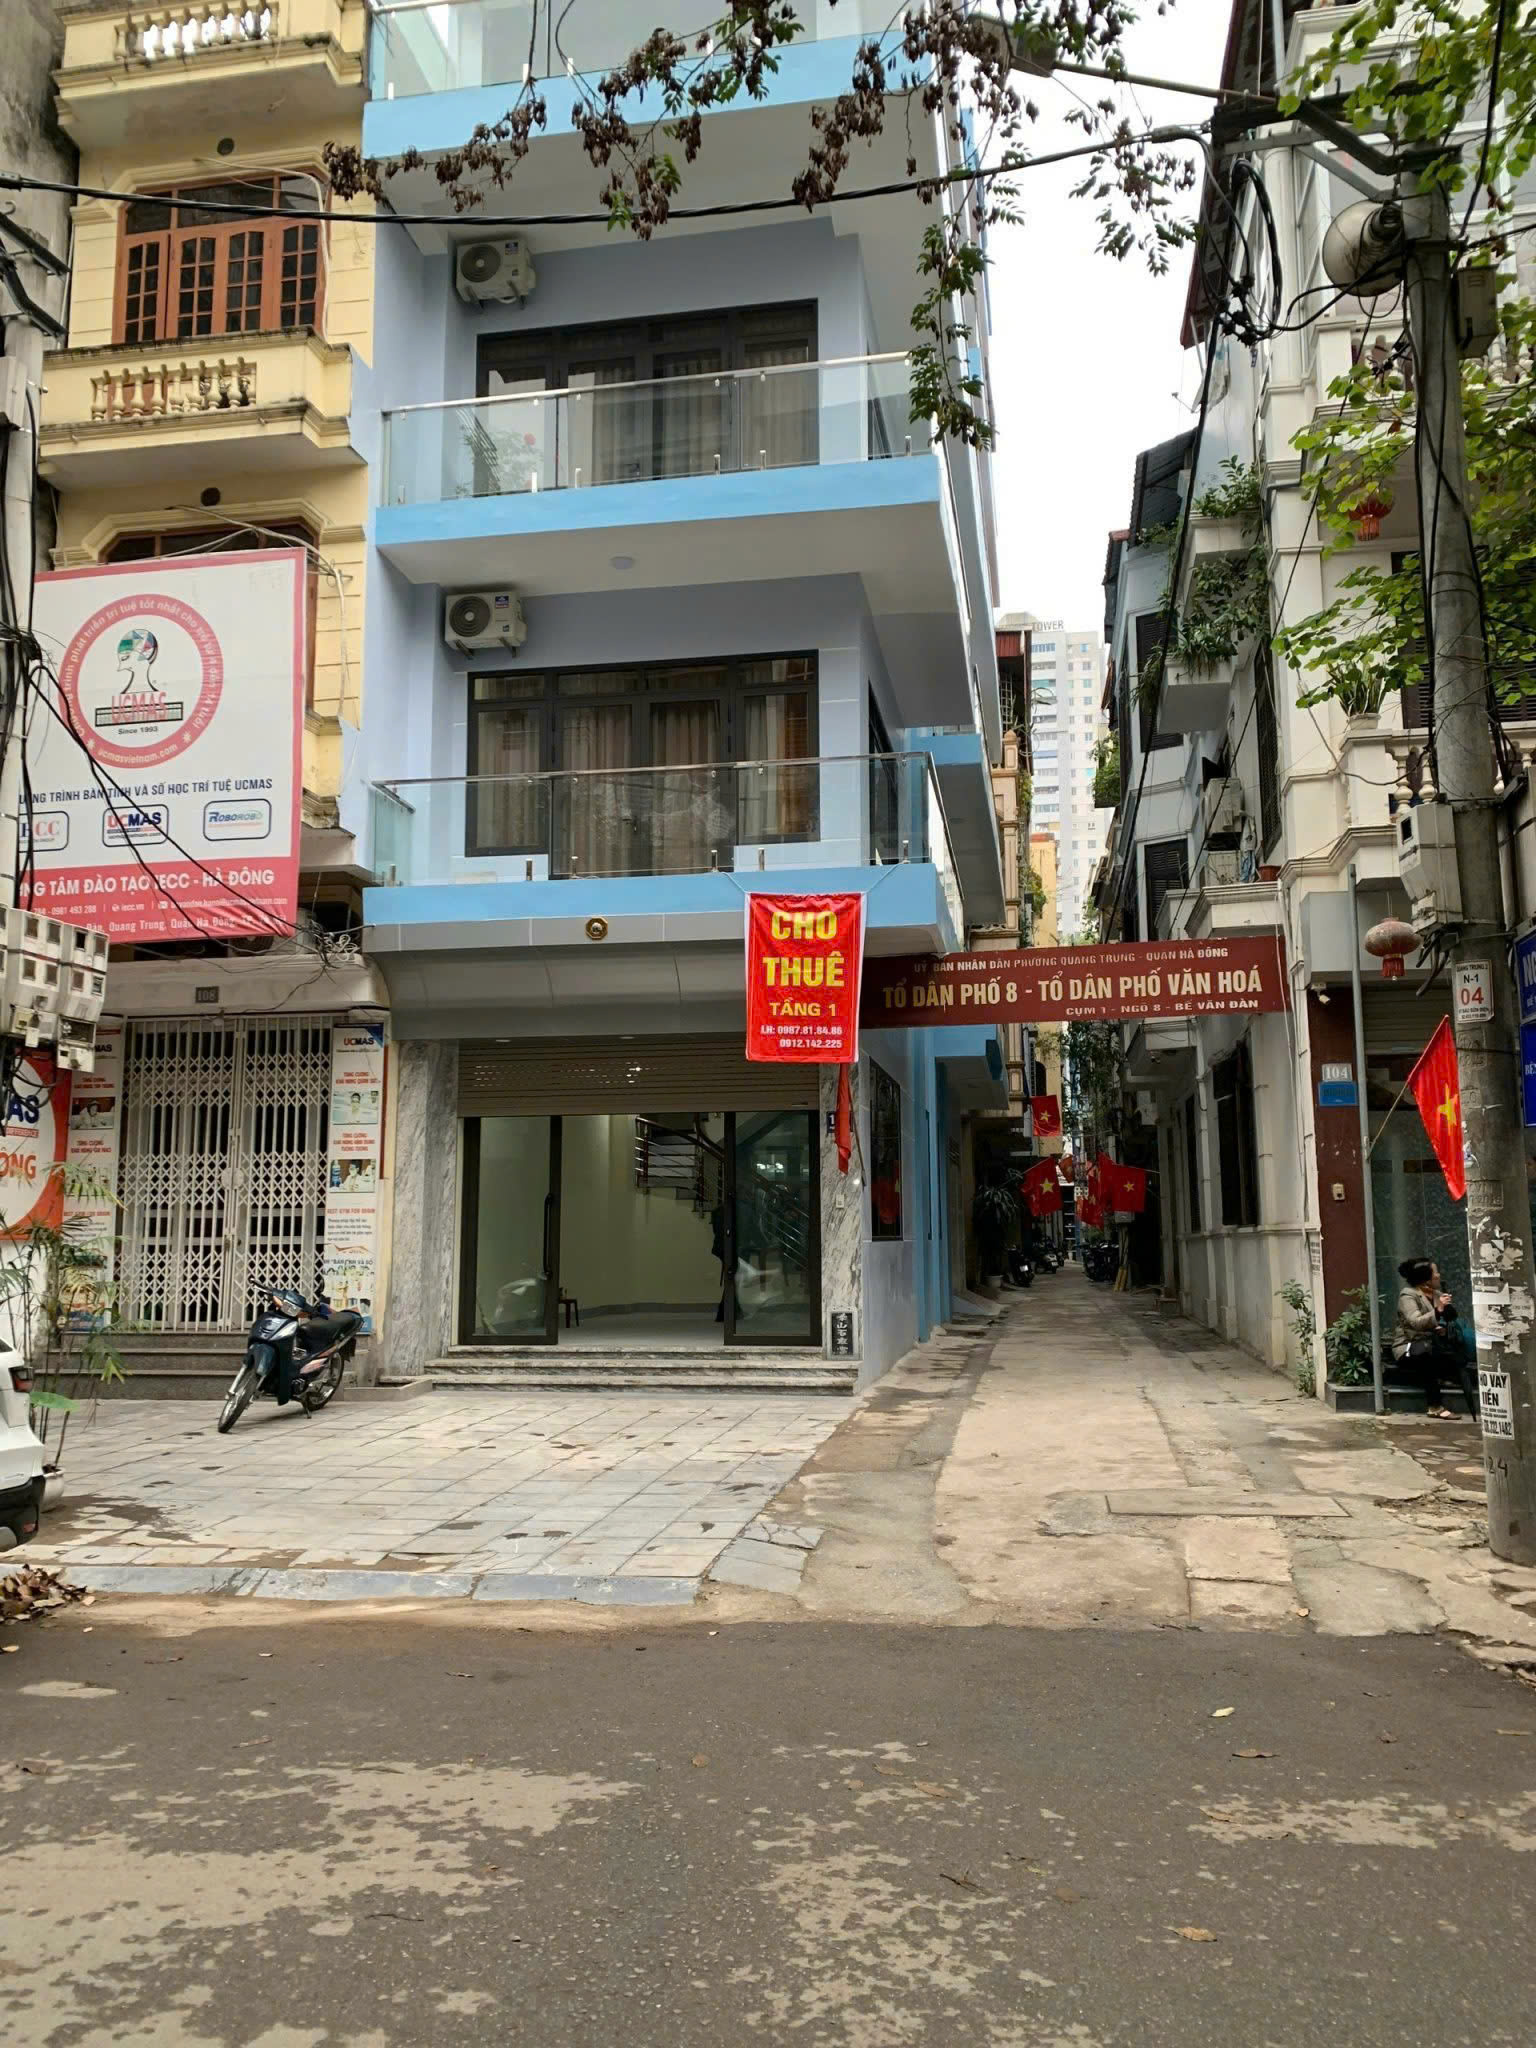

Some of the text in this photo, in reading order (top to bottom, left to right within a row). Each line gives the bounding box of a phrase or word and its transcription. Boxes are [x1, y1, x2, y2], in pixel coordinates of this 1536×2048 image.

[134, 784, 148, 796] VÀ
[168, 783, 189, 796] HỌC
[192, 779, 210, 792] TRÍ
[212, 778, 231, 792] TUỆ
[235, 778, 273, 790] UCMAS
[107, 812, 161, 828] UCMAS
[49, 876, 79, 896] TÂM
[83, 874, 117, 894] ĐÀO
[228, 866, 274, 886] ĐÔNG
[771, 911, 838, 940] CHO
[762, 951, 845, 987] THUÊ
[957, 958, 987, 971] NHÂN
[1100, 952, 1136, 964] TRUNG
[912, 980, 954, 1007] DÂN
[960, 975, 1001, 1006] PHỐ
[1006, 982, 1018, 1003] 8
[1038, 970, 1064, 1002] TỔ
[1069, 973, 1112, 1001] DÂN
[1119, 967, 1161, 998] PHỐ
[1167, 968, 1211, 996] VĂN
[1218, 965, 1263, 994] HOÁ
[1463, 973, 1479, 984] N-1
[1461, 986, 1484, 1006] 04
[829, 1004, 836, 1017] 1
[1153, 1003, 1161, 1012] 8
[1326, 1066, 1348, 1080] 104
[1489, 1374, 1507, 1389] VAY
